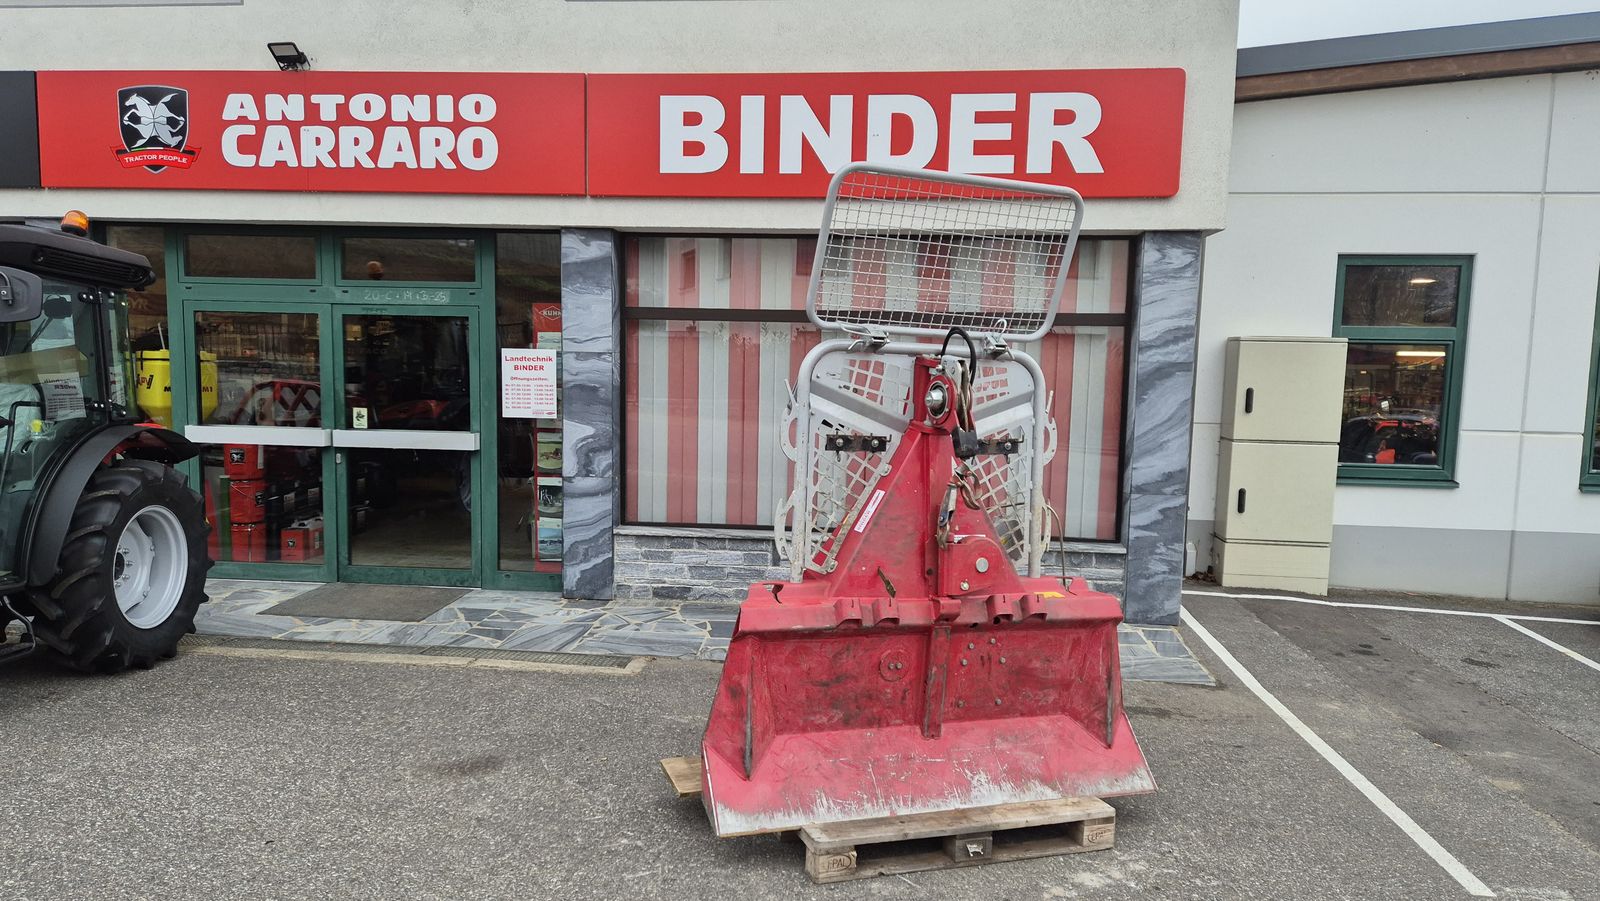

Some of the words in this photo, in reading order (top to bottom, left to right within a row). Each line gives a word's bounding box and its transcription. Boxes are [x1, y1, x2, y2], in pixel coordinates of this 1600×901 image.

[221, 93, 498, 123] ANTONIO
[221, 125, 499, 171] CARRARO
[659, 92, 1105, 175] BINDER
[124, 154, 158, 163] TRACTOR
[158, 154, 188, 164] PEOPLE
